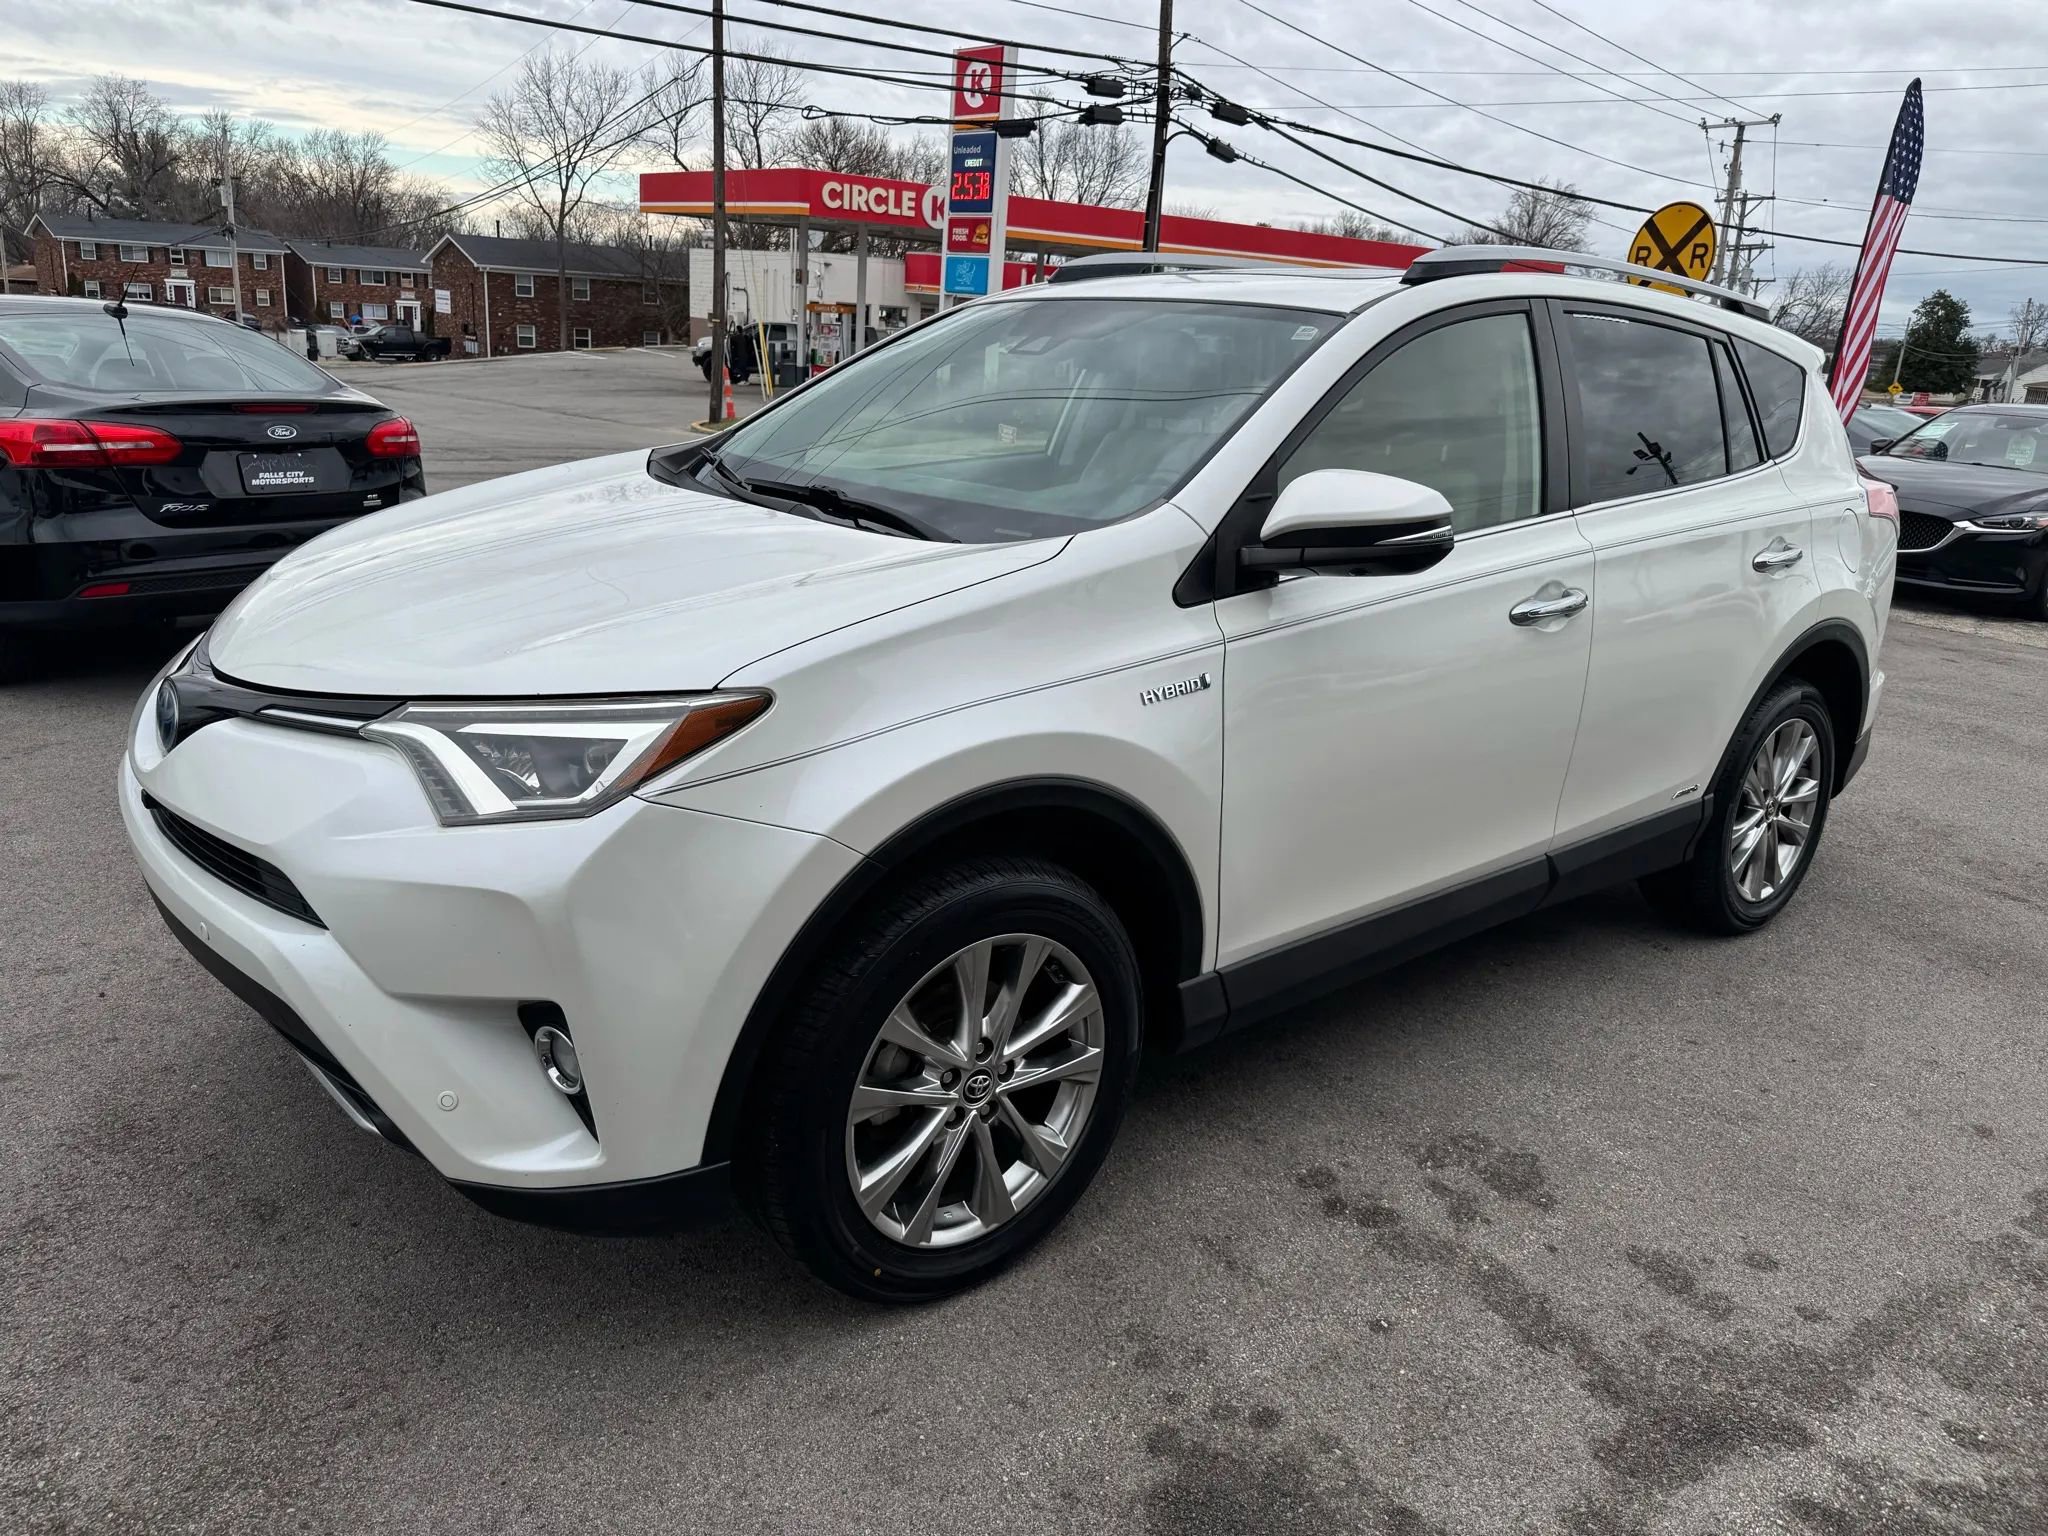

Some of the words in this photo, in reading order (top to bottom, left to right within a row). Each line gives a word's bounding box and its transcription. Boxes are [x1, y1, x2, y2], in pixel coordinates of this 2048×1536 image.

[953, 145, 982, 154] Unleaded
[821, 181, 917, 218] CIRCLE
[1634, 246, 1651, 267] R
[1689, 243, 1709, 269] R
[251, 476, 315, 486] MOTORSPORTS
[258, 471, 285, 479] FALLS
[286, 470, 305, 478] CITY
[1140, 678, 1203, 706] HYBRID
